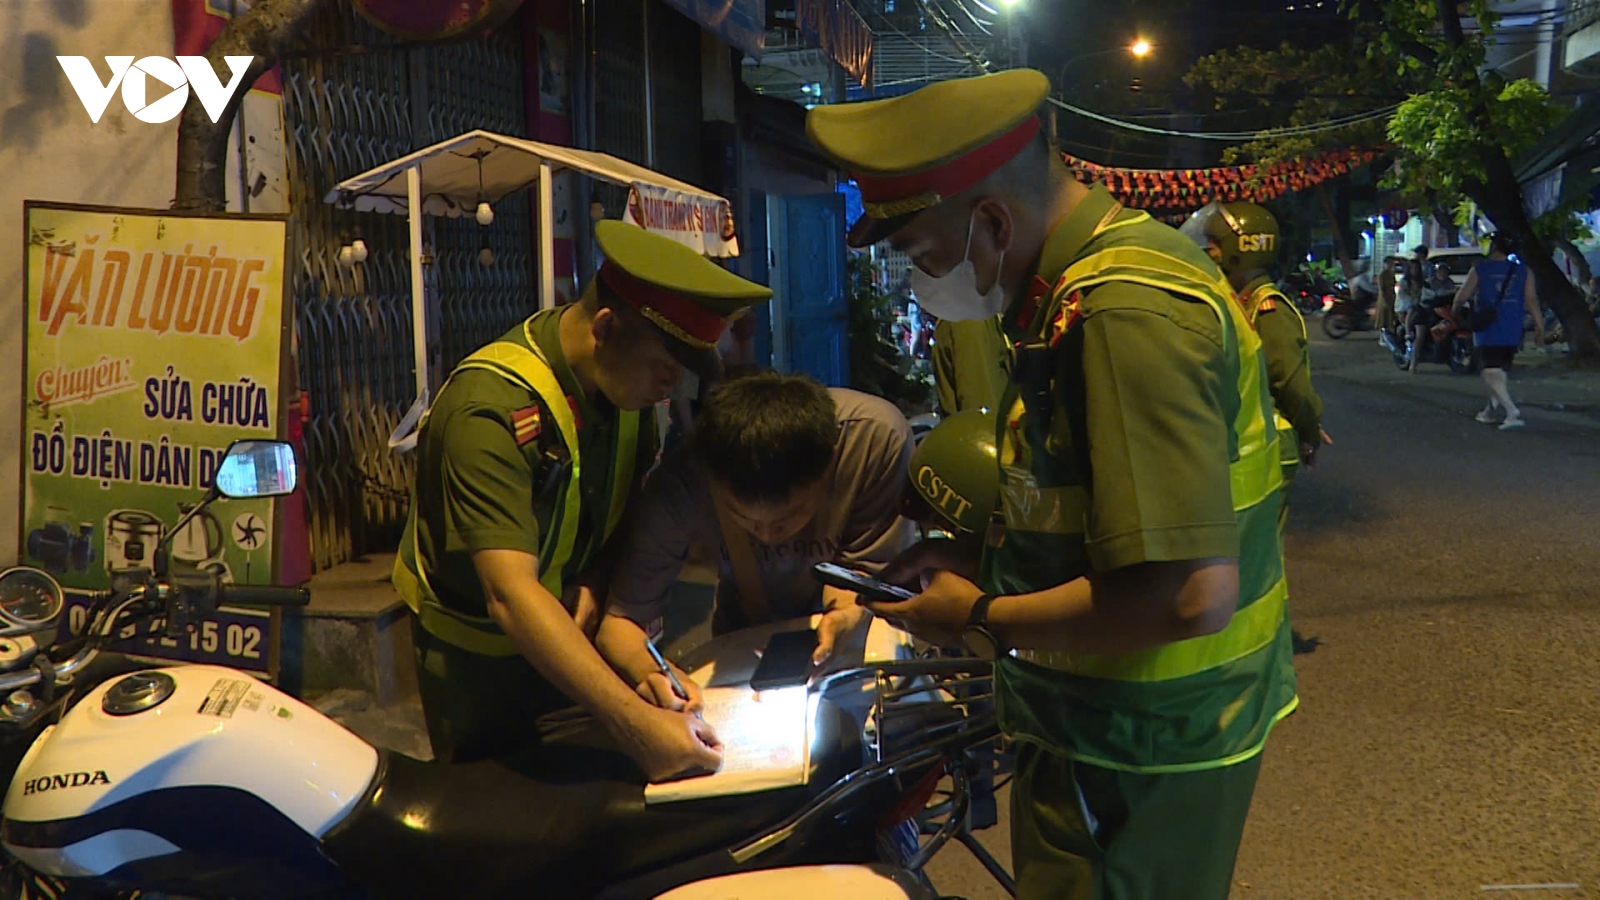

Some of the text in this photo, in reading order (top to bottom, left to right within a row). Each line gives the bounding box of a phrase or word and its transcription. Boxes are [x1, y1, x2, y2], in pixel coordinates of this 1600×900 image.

[1239, 234, 1274, 252] CSTT
[39, 234, 131, 335] VĂN
[144, 365, 269, 428] SỬA CHỮA
[33, 421, 65, 473] ĐỒ
[72, 430, 131, 487] ĐIỆN
[139, 435, 190, 486] DÂN
[917, 465, 973, 521] CSTT
[189, 620, 219, 653] 15
[226, 623, 261, 659] 02
[23, 770, 111, 797] HONDA
